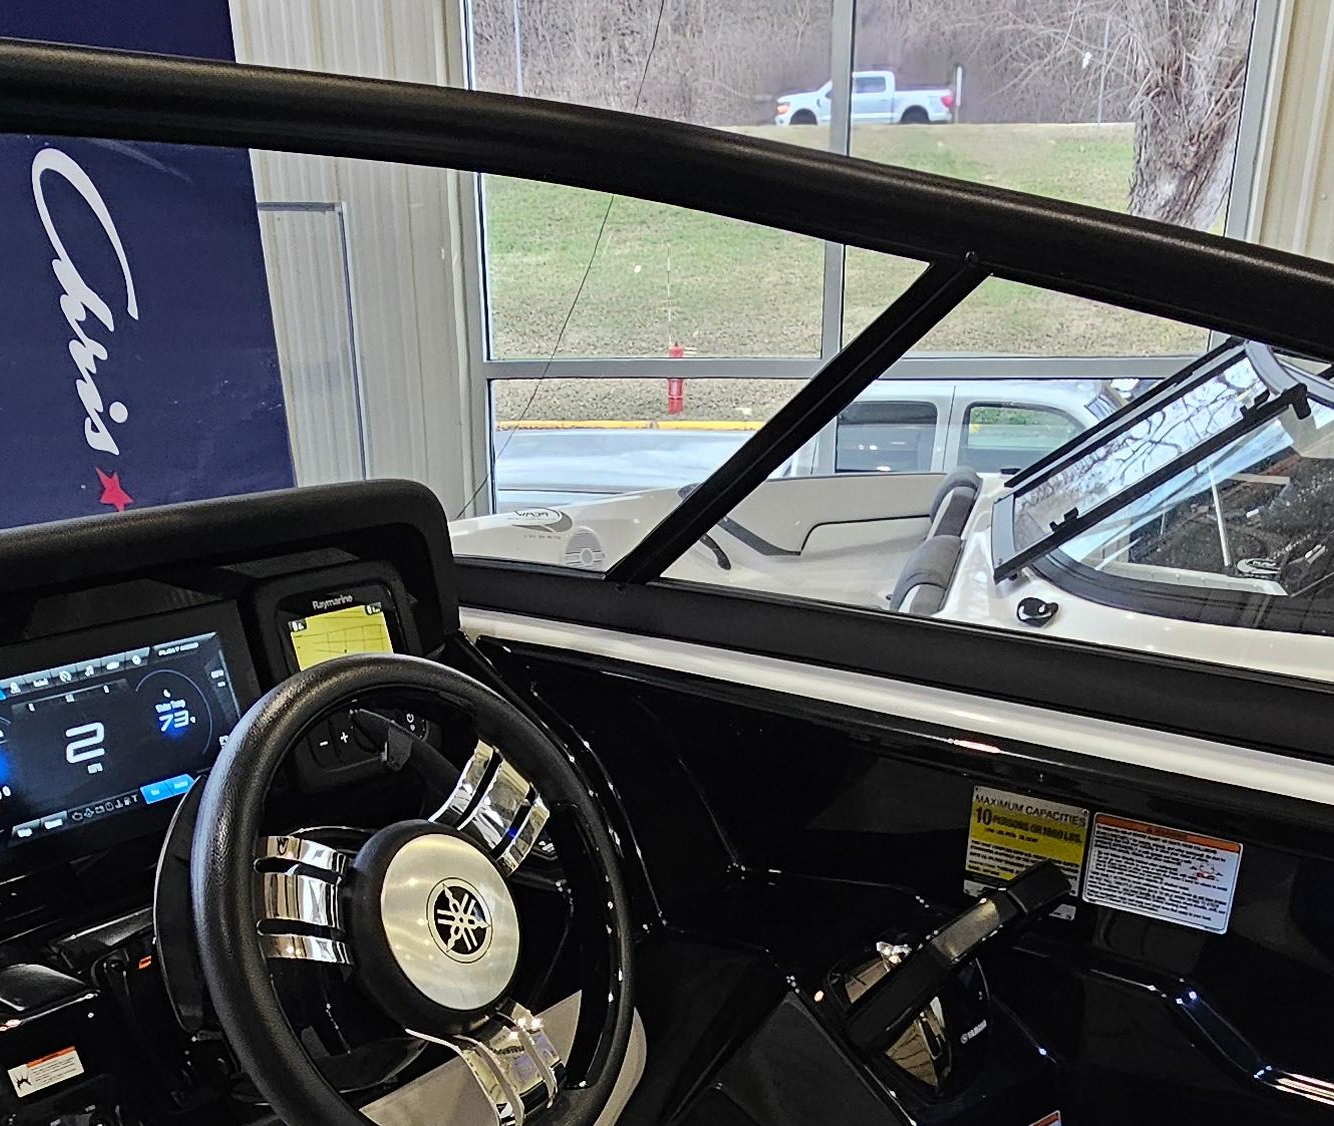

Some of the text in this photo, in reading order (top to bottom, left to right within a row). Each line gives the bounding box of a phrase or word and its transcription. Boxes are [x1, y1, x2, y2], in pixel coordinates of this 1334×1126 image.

[32, 148, 138, 455] Chris
[312, 594, 354, 610] Raymarine
[158, 710, 189, 732] 73
[65, 722, 105, 763] 2
[975, 794, 1086, 828] MAXIMUM CAPACITIES
[975, 806, 992, 826] 10
